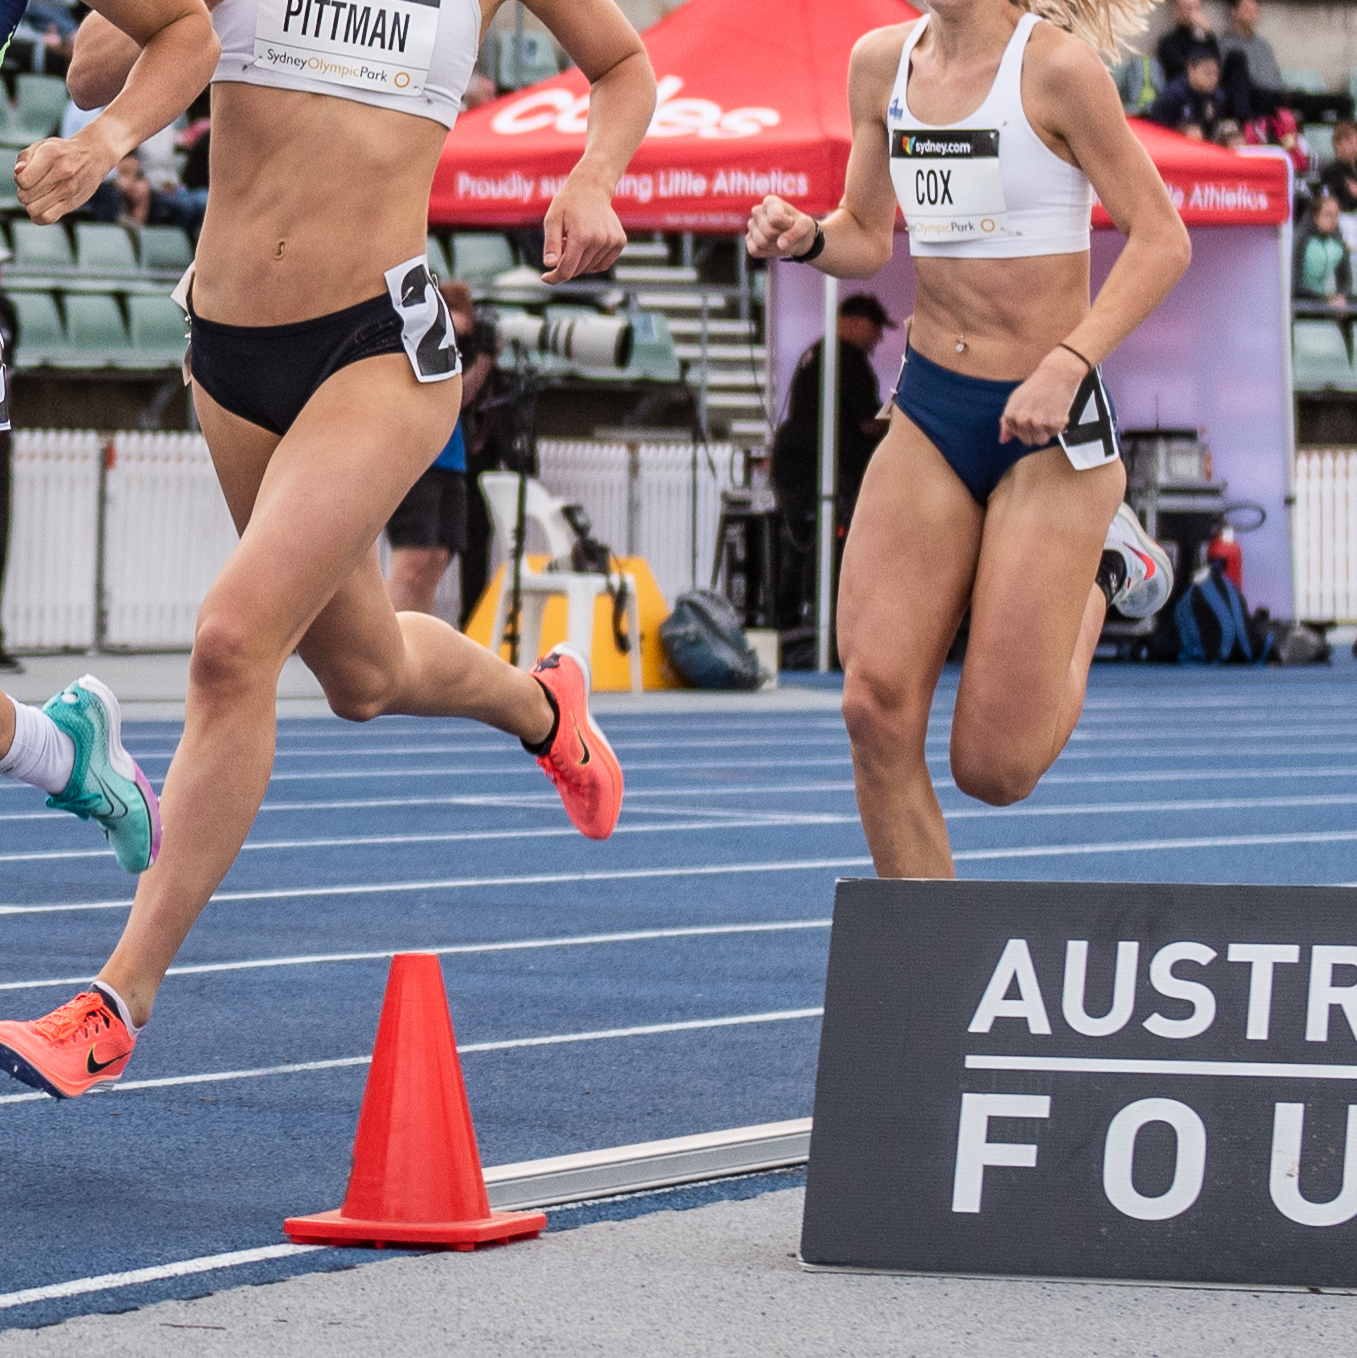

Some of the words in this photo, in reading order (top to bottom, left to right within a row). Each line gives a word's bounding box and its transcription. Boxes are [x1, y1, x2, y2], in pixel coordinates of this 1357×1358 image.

[915, 140, 971, 156] sydney.com
[457, 171, 535, 204] Proudly
[657, 169, 707, 197] Little
[712, 169, 808, 197] Athletics
[915, 169, 954, 205] COX
[1188, 183, 1269, 211] Athletics
[400, 263, 457, 377] 2
[1061, 367, 1116, 458] 4
